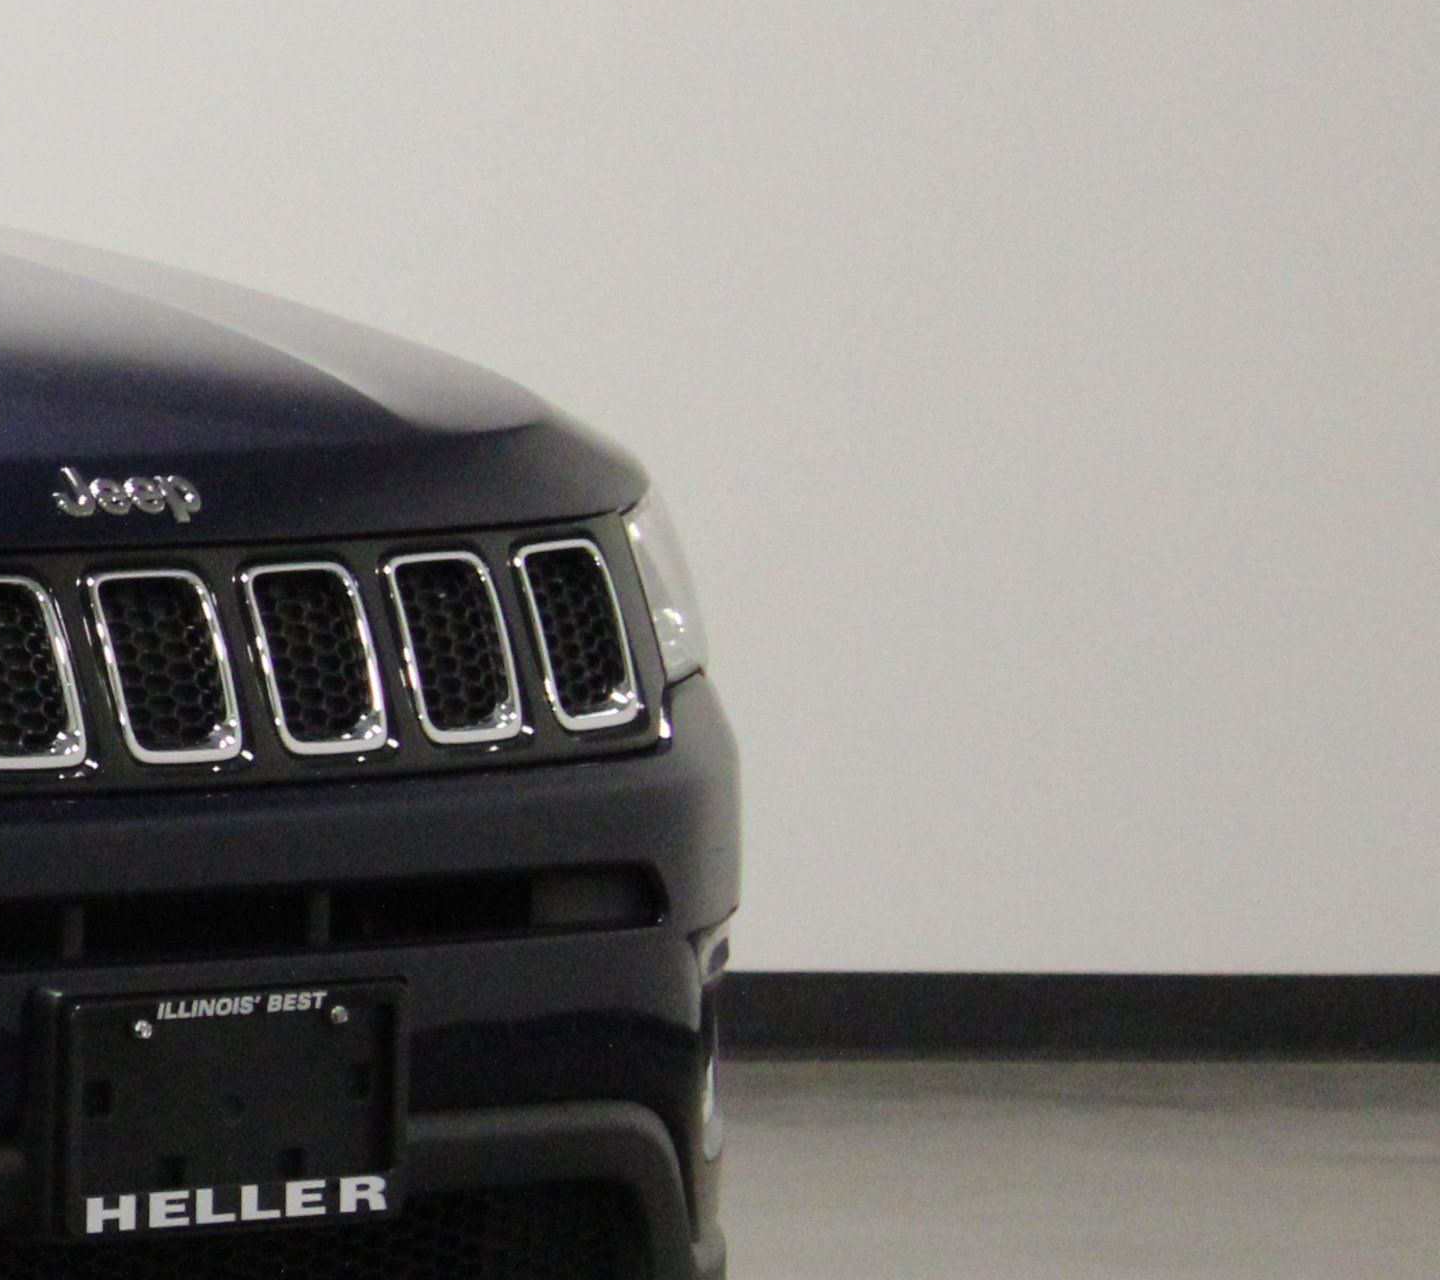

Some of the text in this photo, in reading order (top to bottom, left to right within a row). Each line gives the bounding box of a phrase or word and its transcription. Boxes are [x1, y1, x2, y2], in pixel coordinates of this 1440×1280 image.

[52, 466, 202, 524] Jeep
[267, 990, 328, 1013] BEST
[85, 1174, 388, 1235] HELLER
